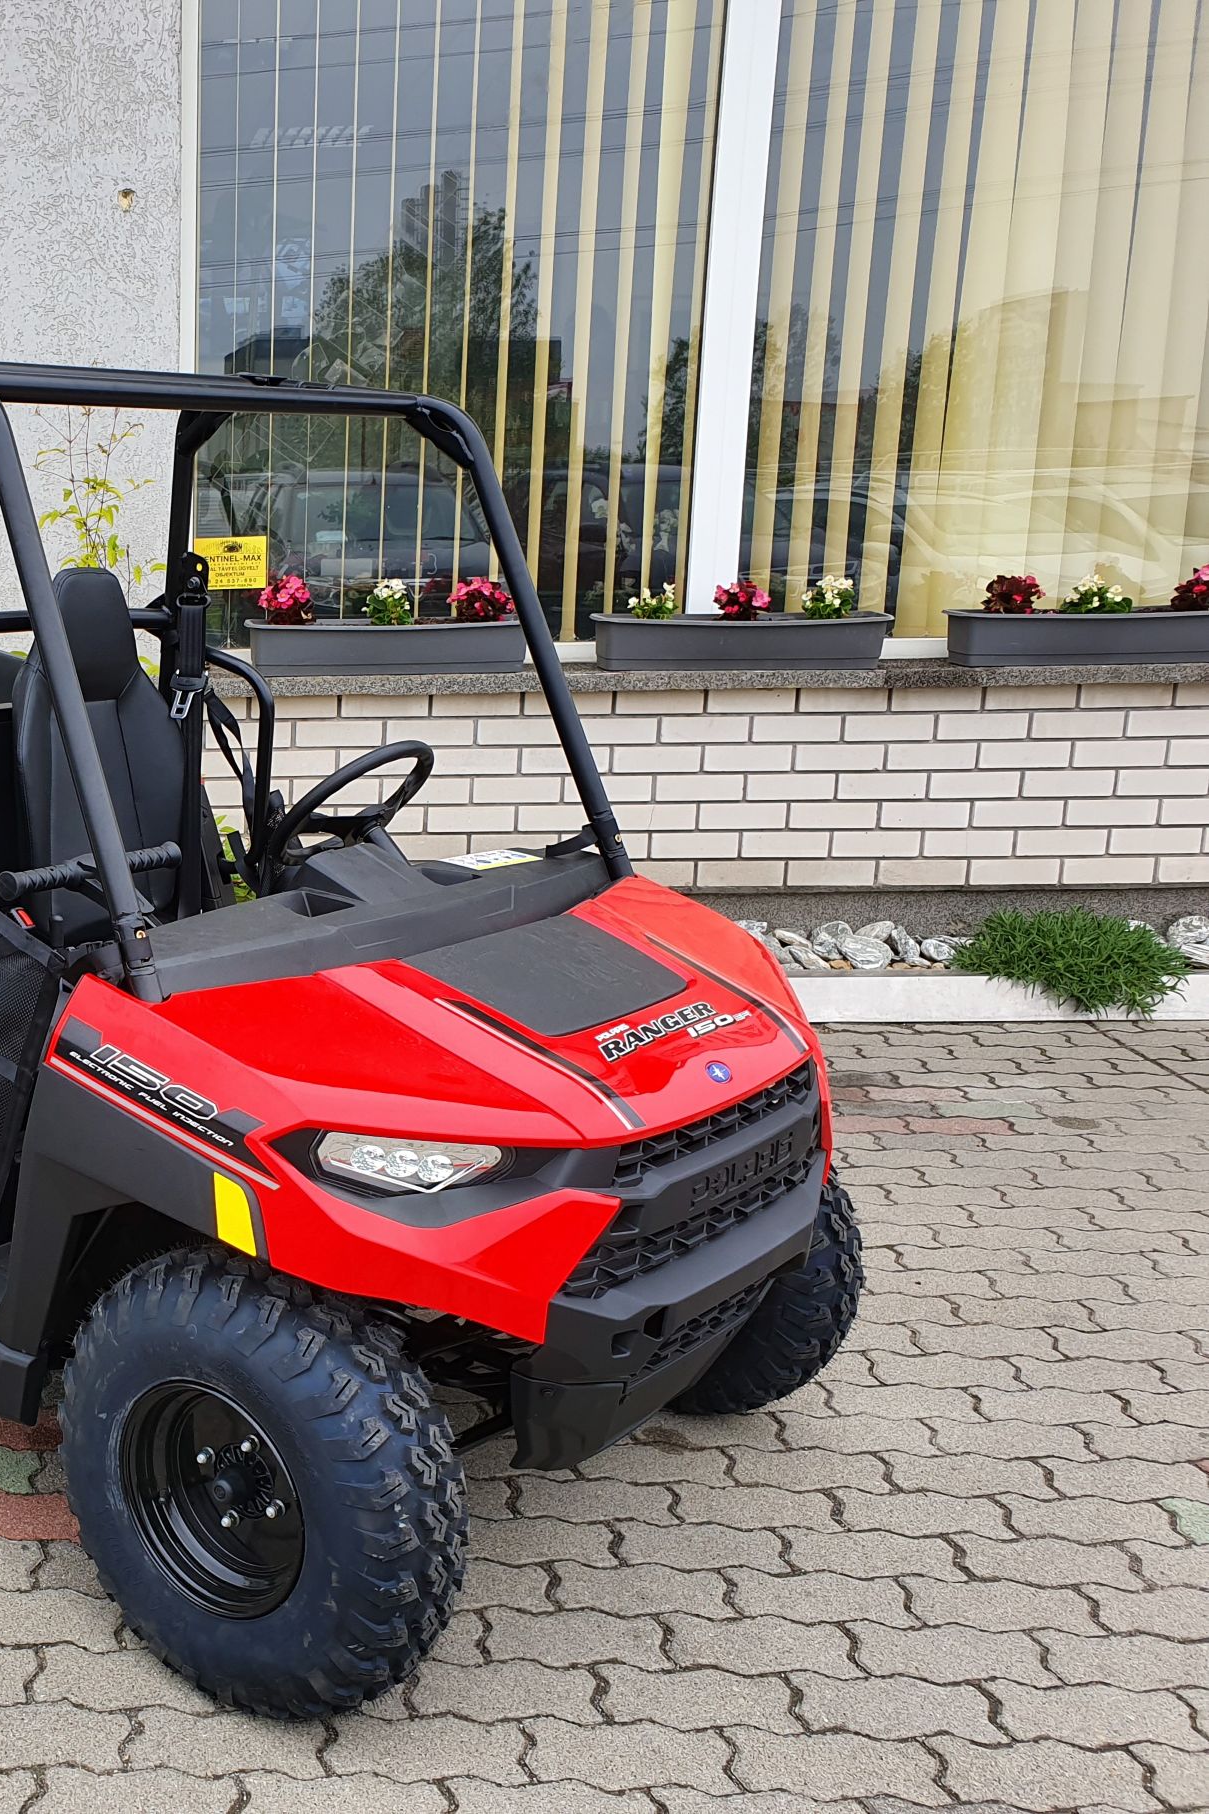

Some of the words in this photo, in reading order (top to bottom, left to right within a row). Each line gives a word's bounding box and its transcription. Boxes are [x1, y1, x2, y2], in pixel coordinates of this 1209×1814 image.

[205, 554, 262, 562] ENTINEL-MAX
[598, 1001, 718, 1063] RANGER
[686, 1013, 735, 1039] 150
[68, 1050, 135, 1092] ELECTRONIC
[137, 1090, 169, 1112] FUEL
[172, 1110, 235, 1147] INJECTION
[89, 1043, 220, 1121] 150
